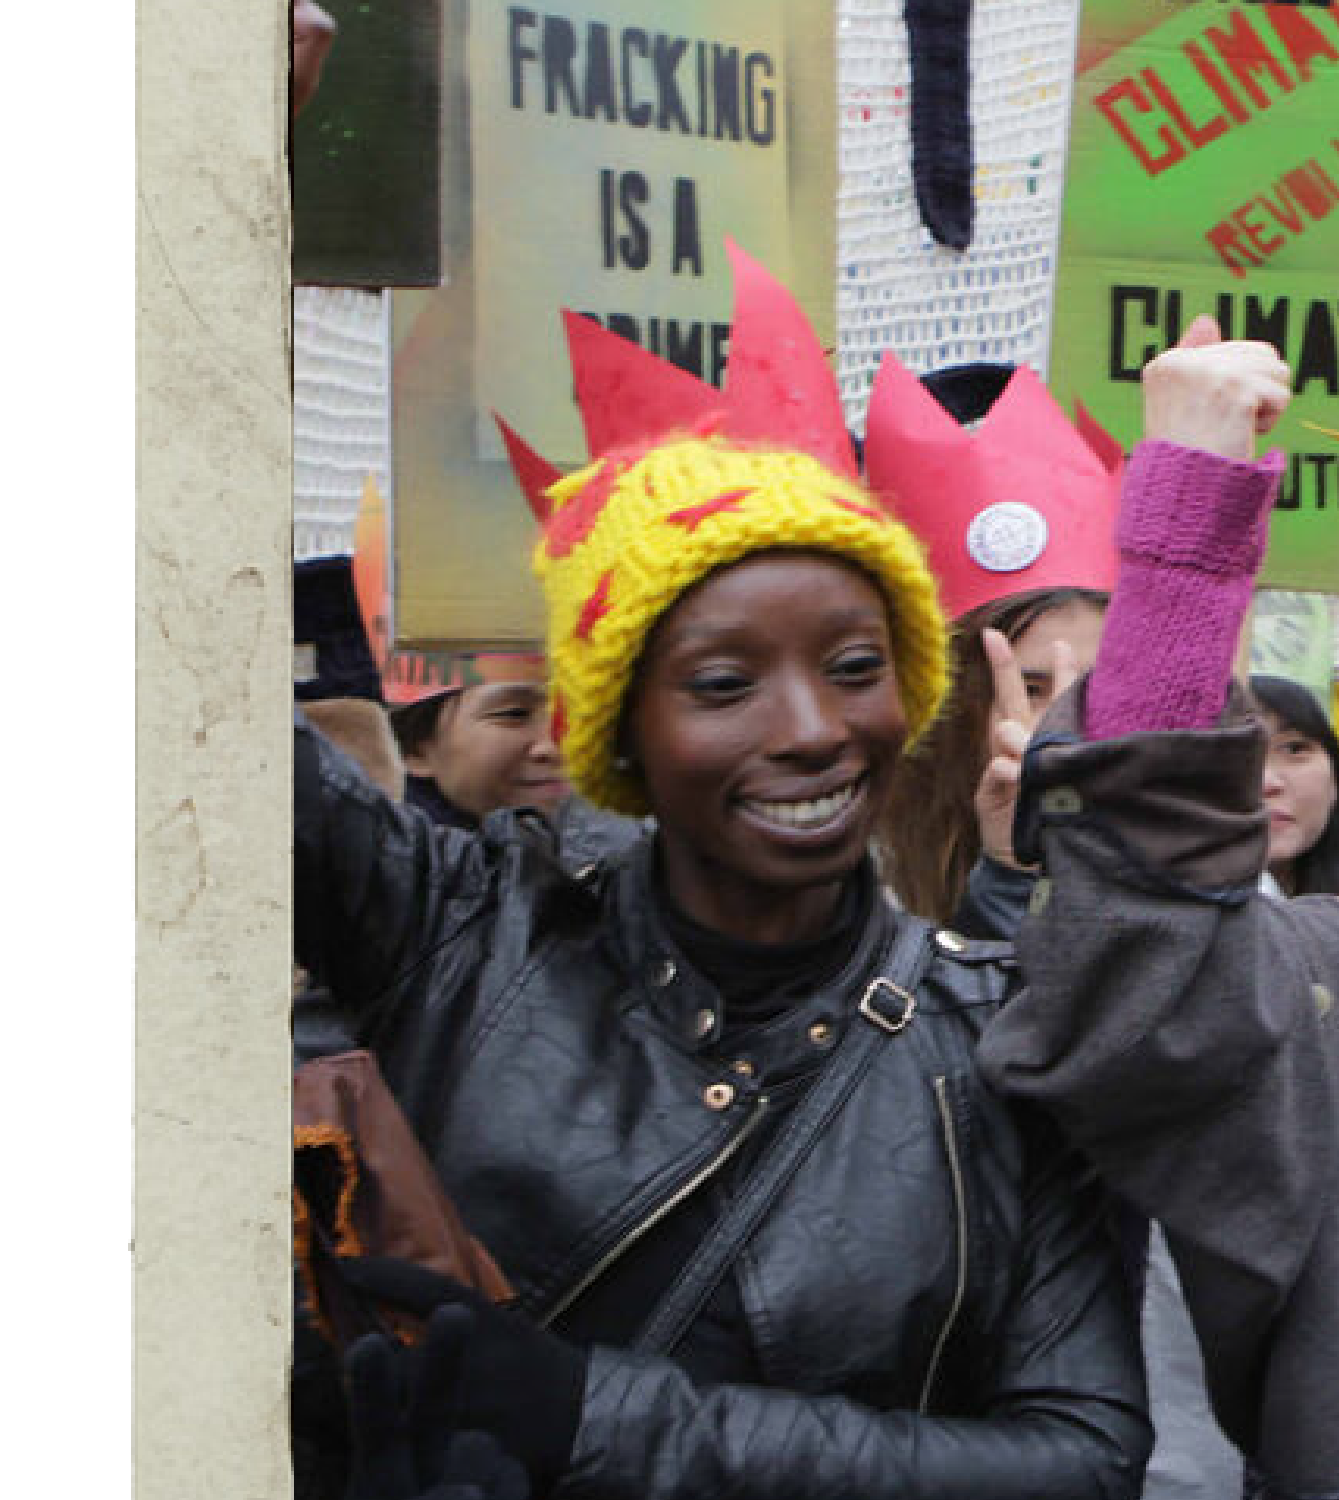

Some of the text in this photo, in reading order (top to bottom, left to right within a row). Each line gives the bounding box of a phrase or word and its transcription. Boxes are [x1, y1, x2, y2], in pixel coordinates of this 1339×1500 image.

[507, 5, 777, 147] FRACKING
[600, 168, 703, 278] IS A
